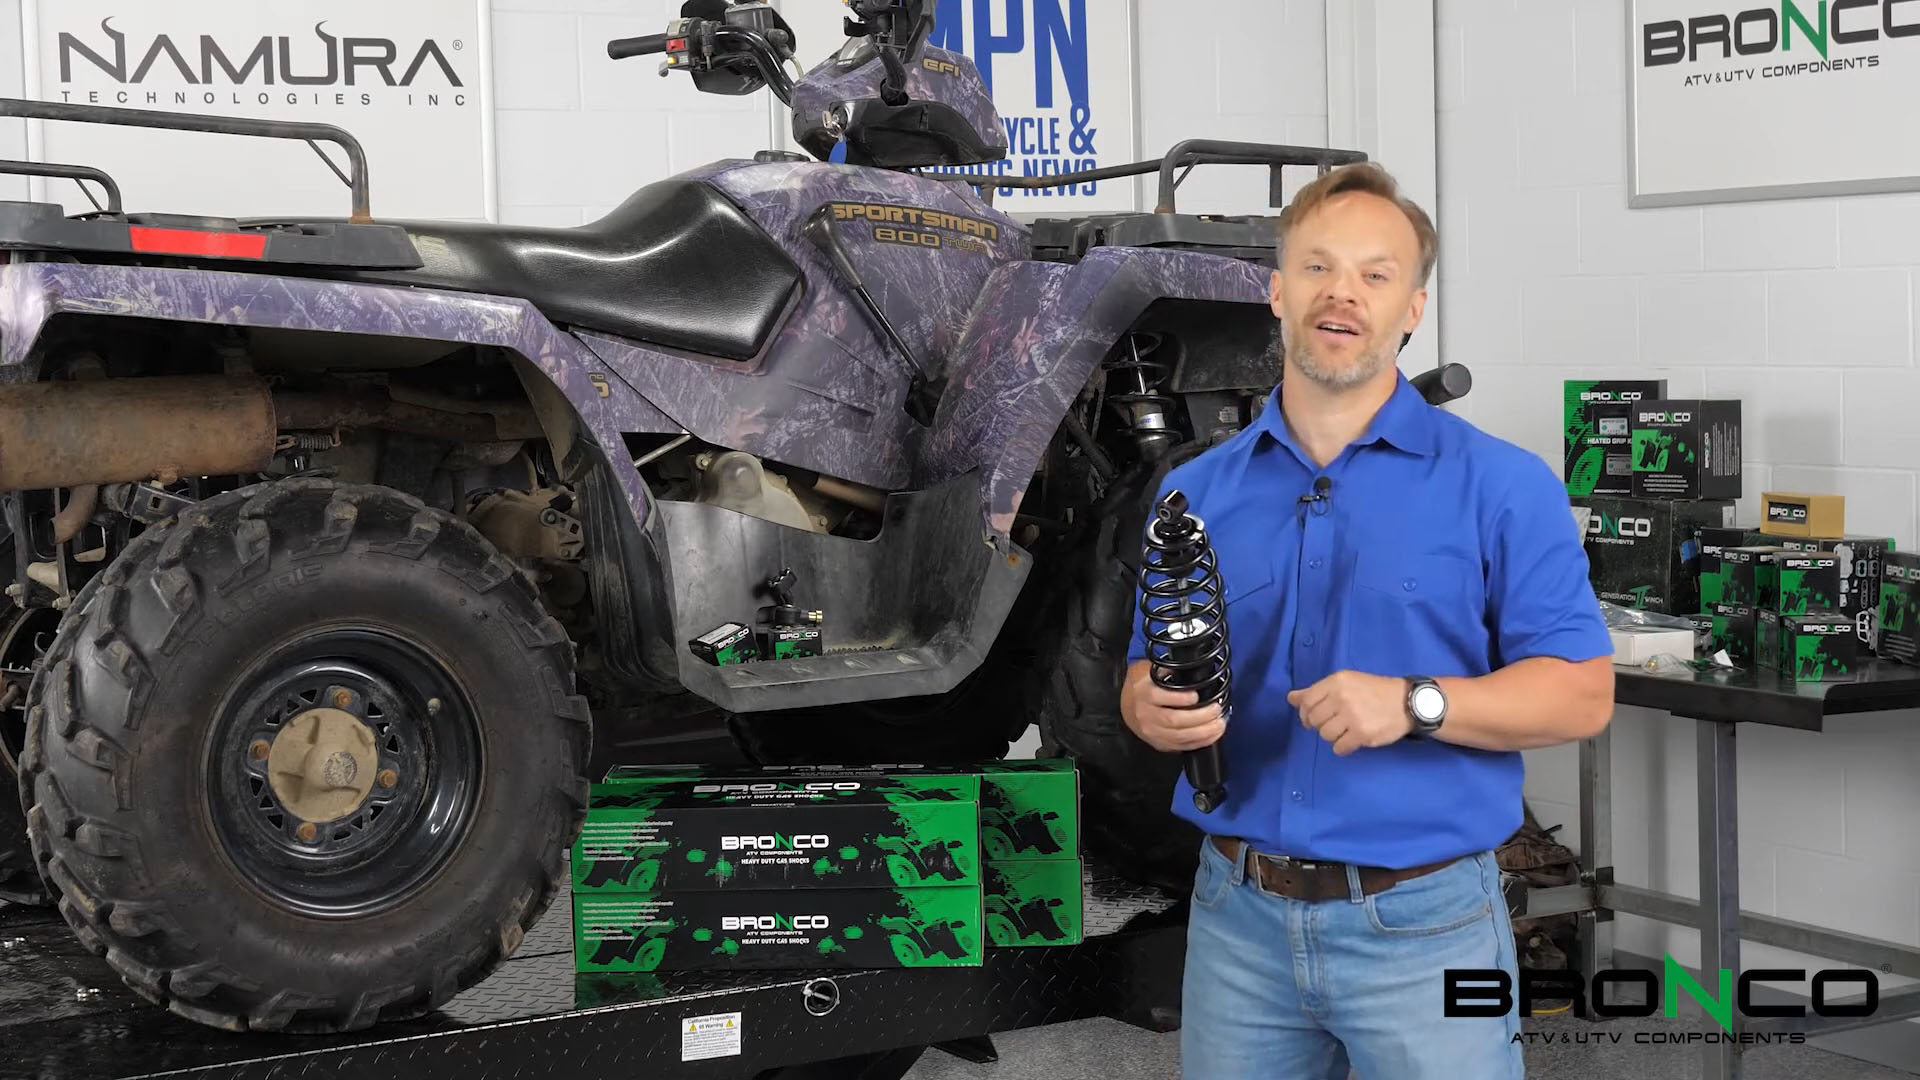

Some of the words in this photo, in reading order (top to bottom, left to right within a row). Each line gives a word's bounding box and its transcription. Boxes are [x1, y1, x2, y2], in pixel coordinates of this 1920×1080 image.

[1643, 0, 1920, 67] BRONCO
[923, 58, 960, 77] EFI
[1762, 55, 1880, 79] COMPONENTS
[61, 90, 371, 106] TECHNOLOGIES
[409, 94, 466, 107] INC
[1068, 101, 1097, 155] &
[1023, 158, 1097, 197] NEWS
[831, 203, 997, 241] SPORTSMAN
[875, 228, 940, 247] 800
[1581, 391, 1642, 402] BRONCO
[1639, 410, 1691, 424] BRONCO
[1770, 507, 1806, 519] BRONCO
[1588, 512, 1651, 539] ONCO
[1786, 560, 1834, 568] BRONCO
[1601, 591, 1636, 601] GENERATION
[780, 631, 818, 640] BRONCO
[1803, 624, 1851, 632] BRONCO
[718, 628, 750, 649] BRONCO
[693, 782, 861, 794] BRONCO
[721, 831, 830, 851] BRONCO
[789, 857, 810, 865] SHOCKS
[721, 912, 830, 931] BRONCO
